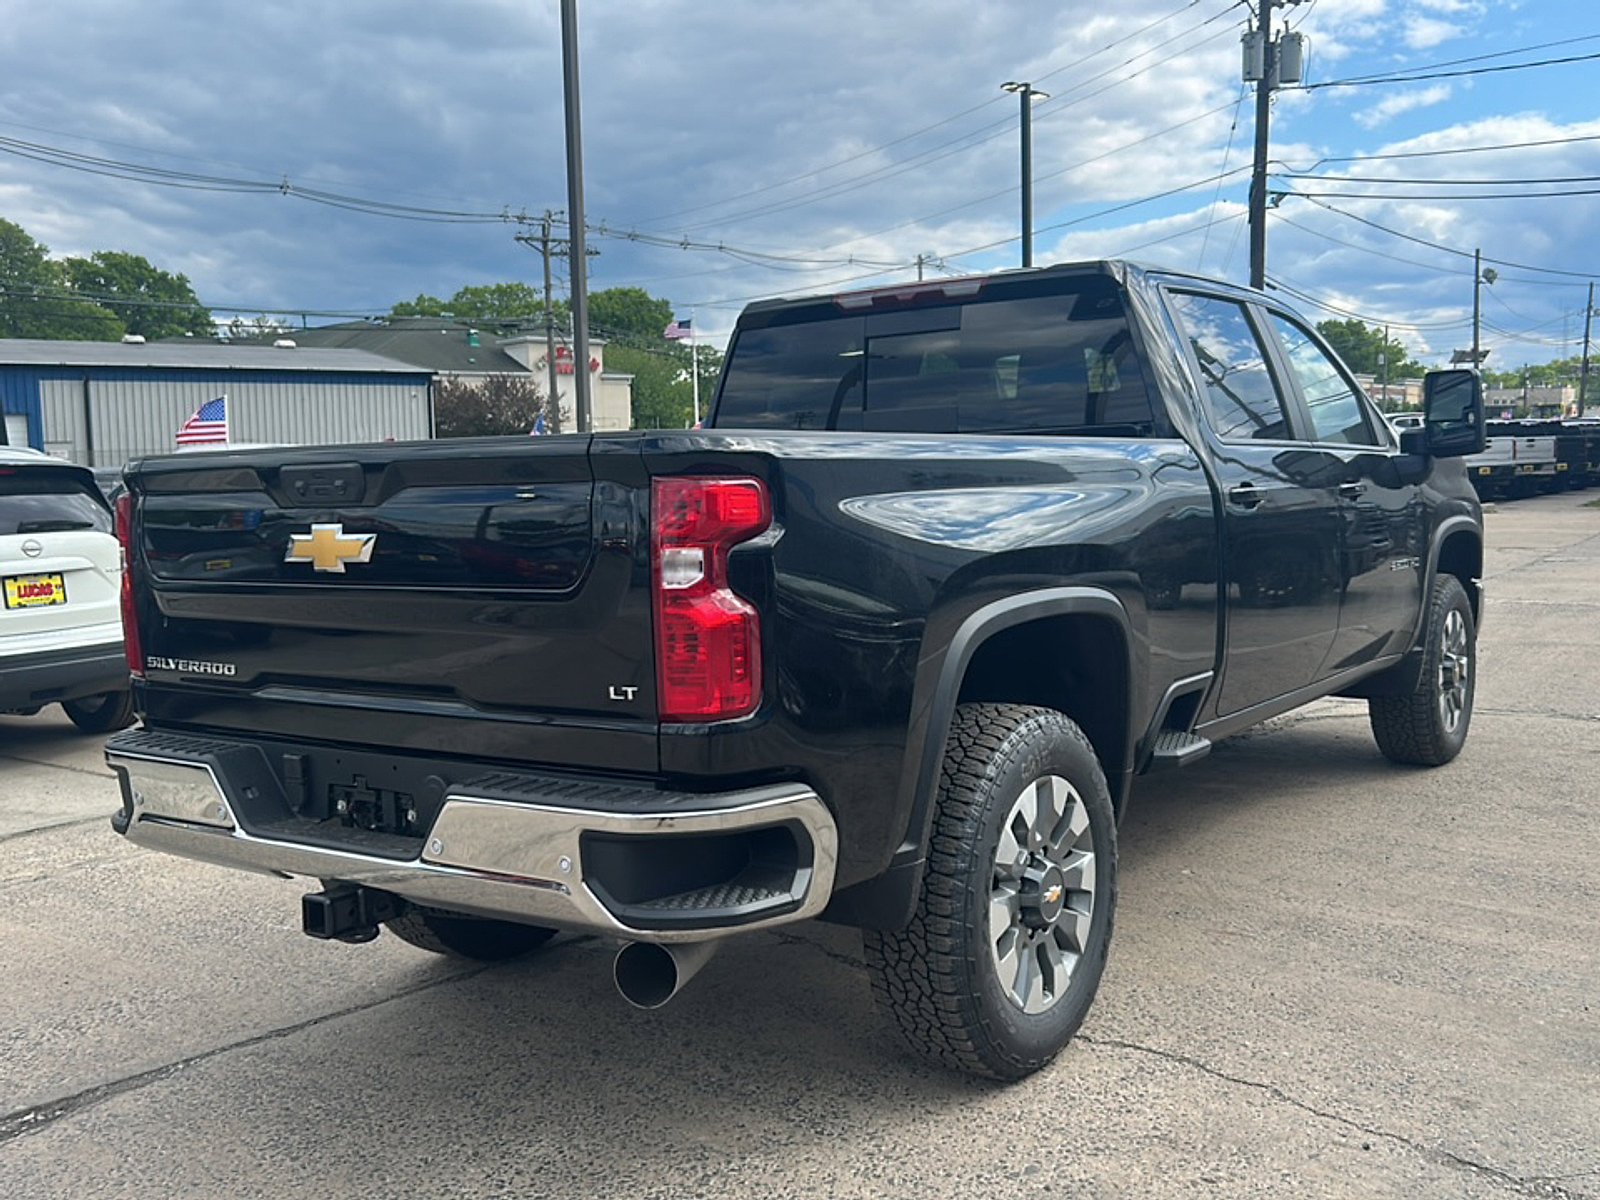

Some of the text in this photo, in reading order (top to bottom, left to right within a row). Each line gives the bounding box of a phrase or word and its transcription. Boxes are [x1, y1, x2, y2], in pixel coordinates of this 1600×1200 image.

[17, 583, 54, 598] LUCAS
[147, 656, 236, 675] SILVERADO
[609, 686, 638, 700] LT
